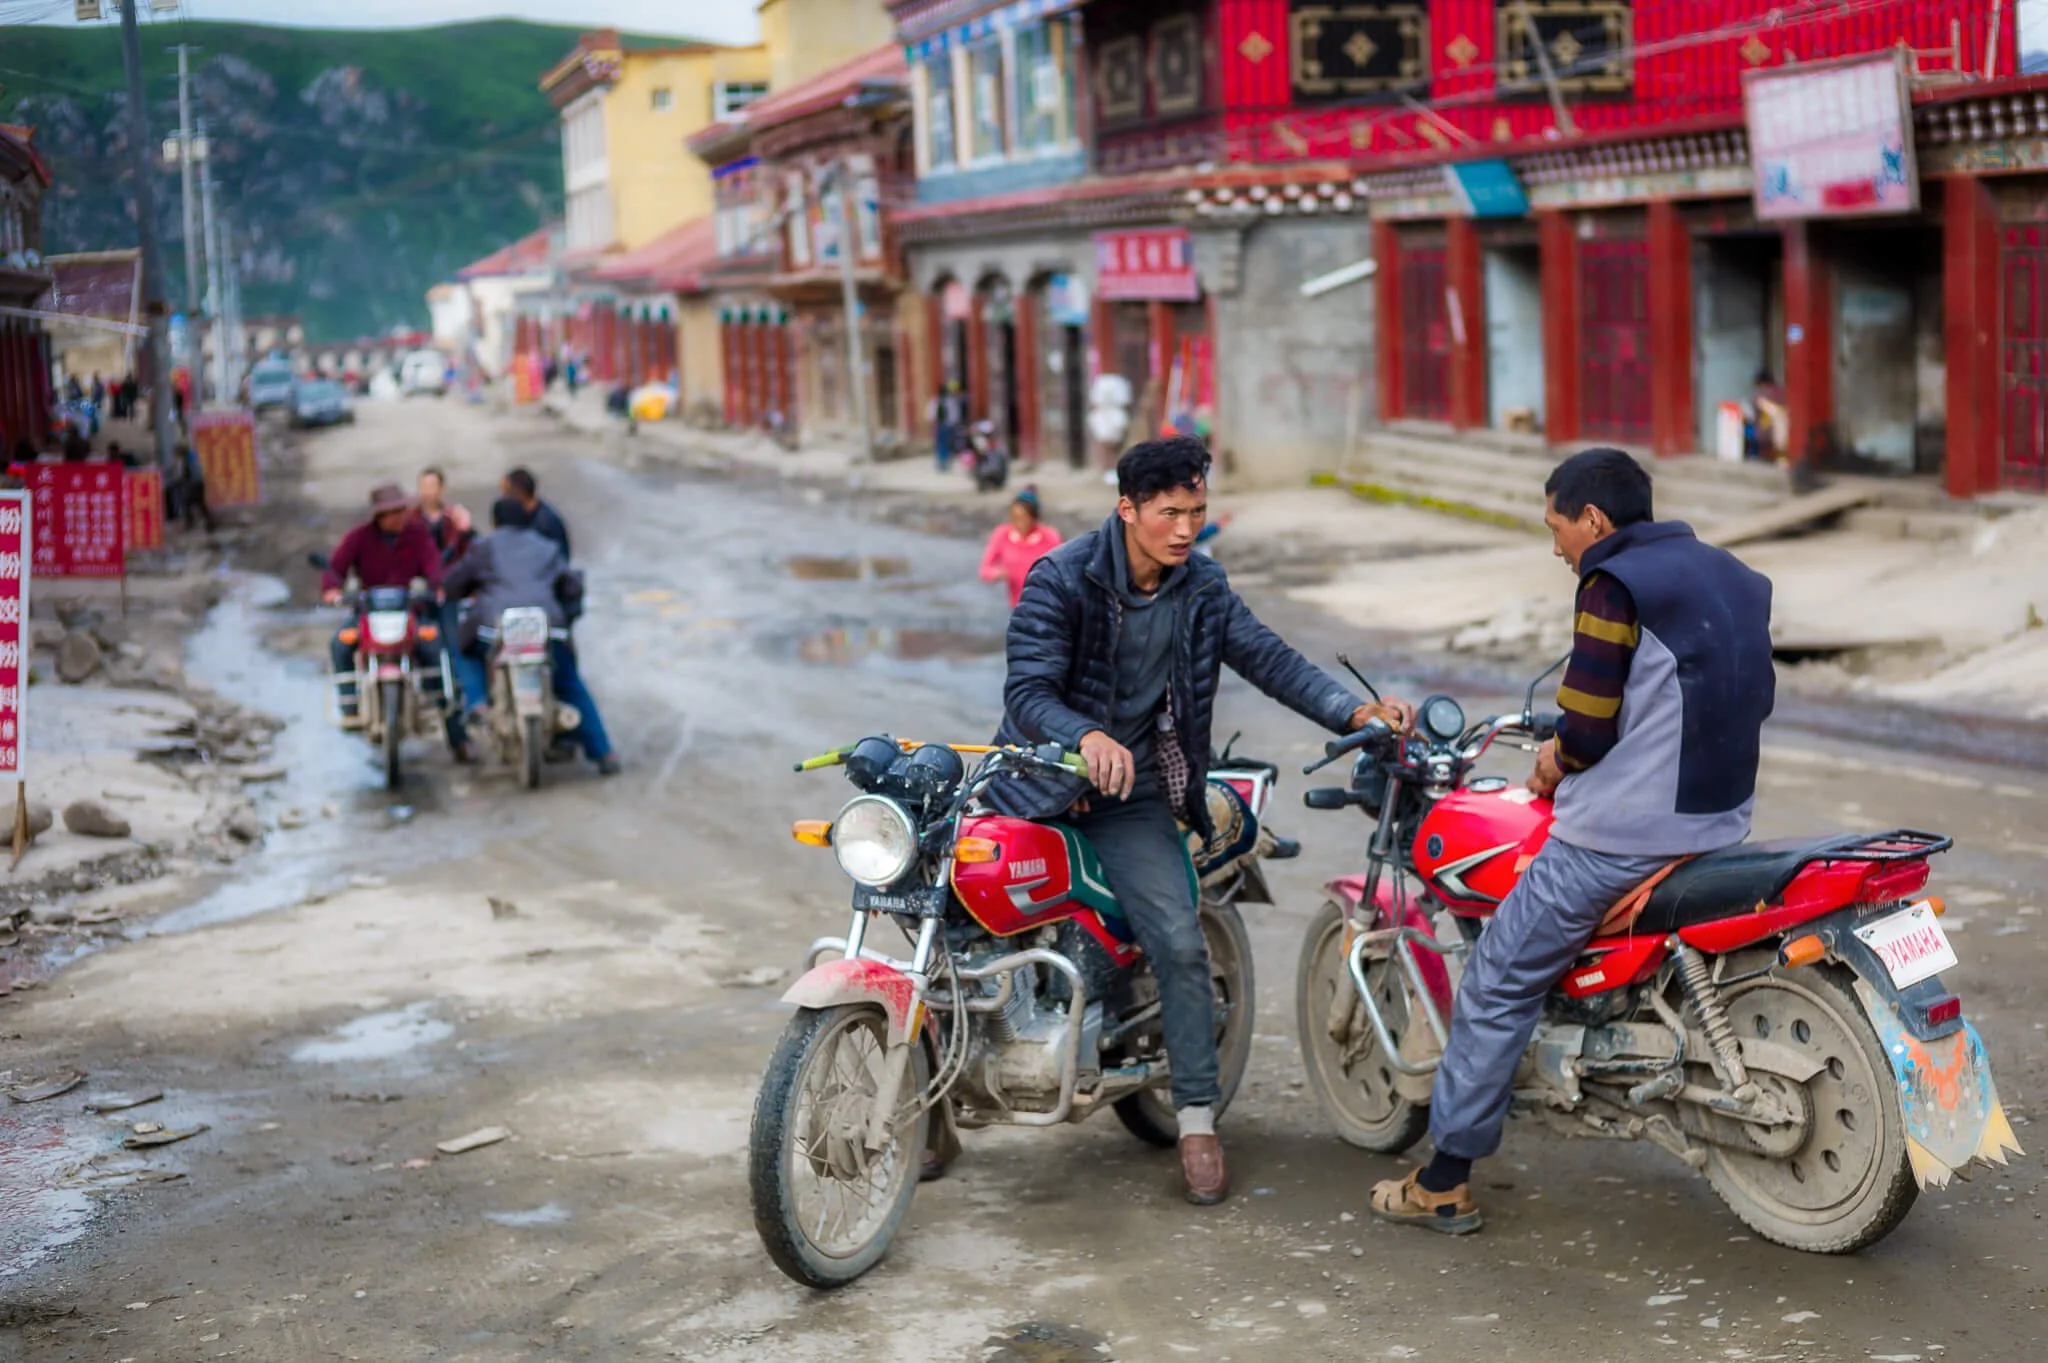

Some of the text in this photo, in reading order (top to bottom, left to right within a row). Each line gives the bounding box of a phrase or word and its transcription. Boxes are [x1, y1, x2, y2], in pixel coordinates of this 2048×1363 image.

[1008, 858, 1047, 880] YAMAHA
[869, 895, 906, 909] YAMAHA
[1887, 926, 1943, 969] YAMAHA
